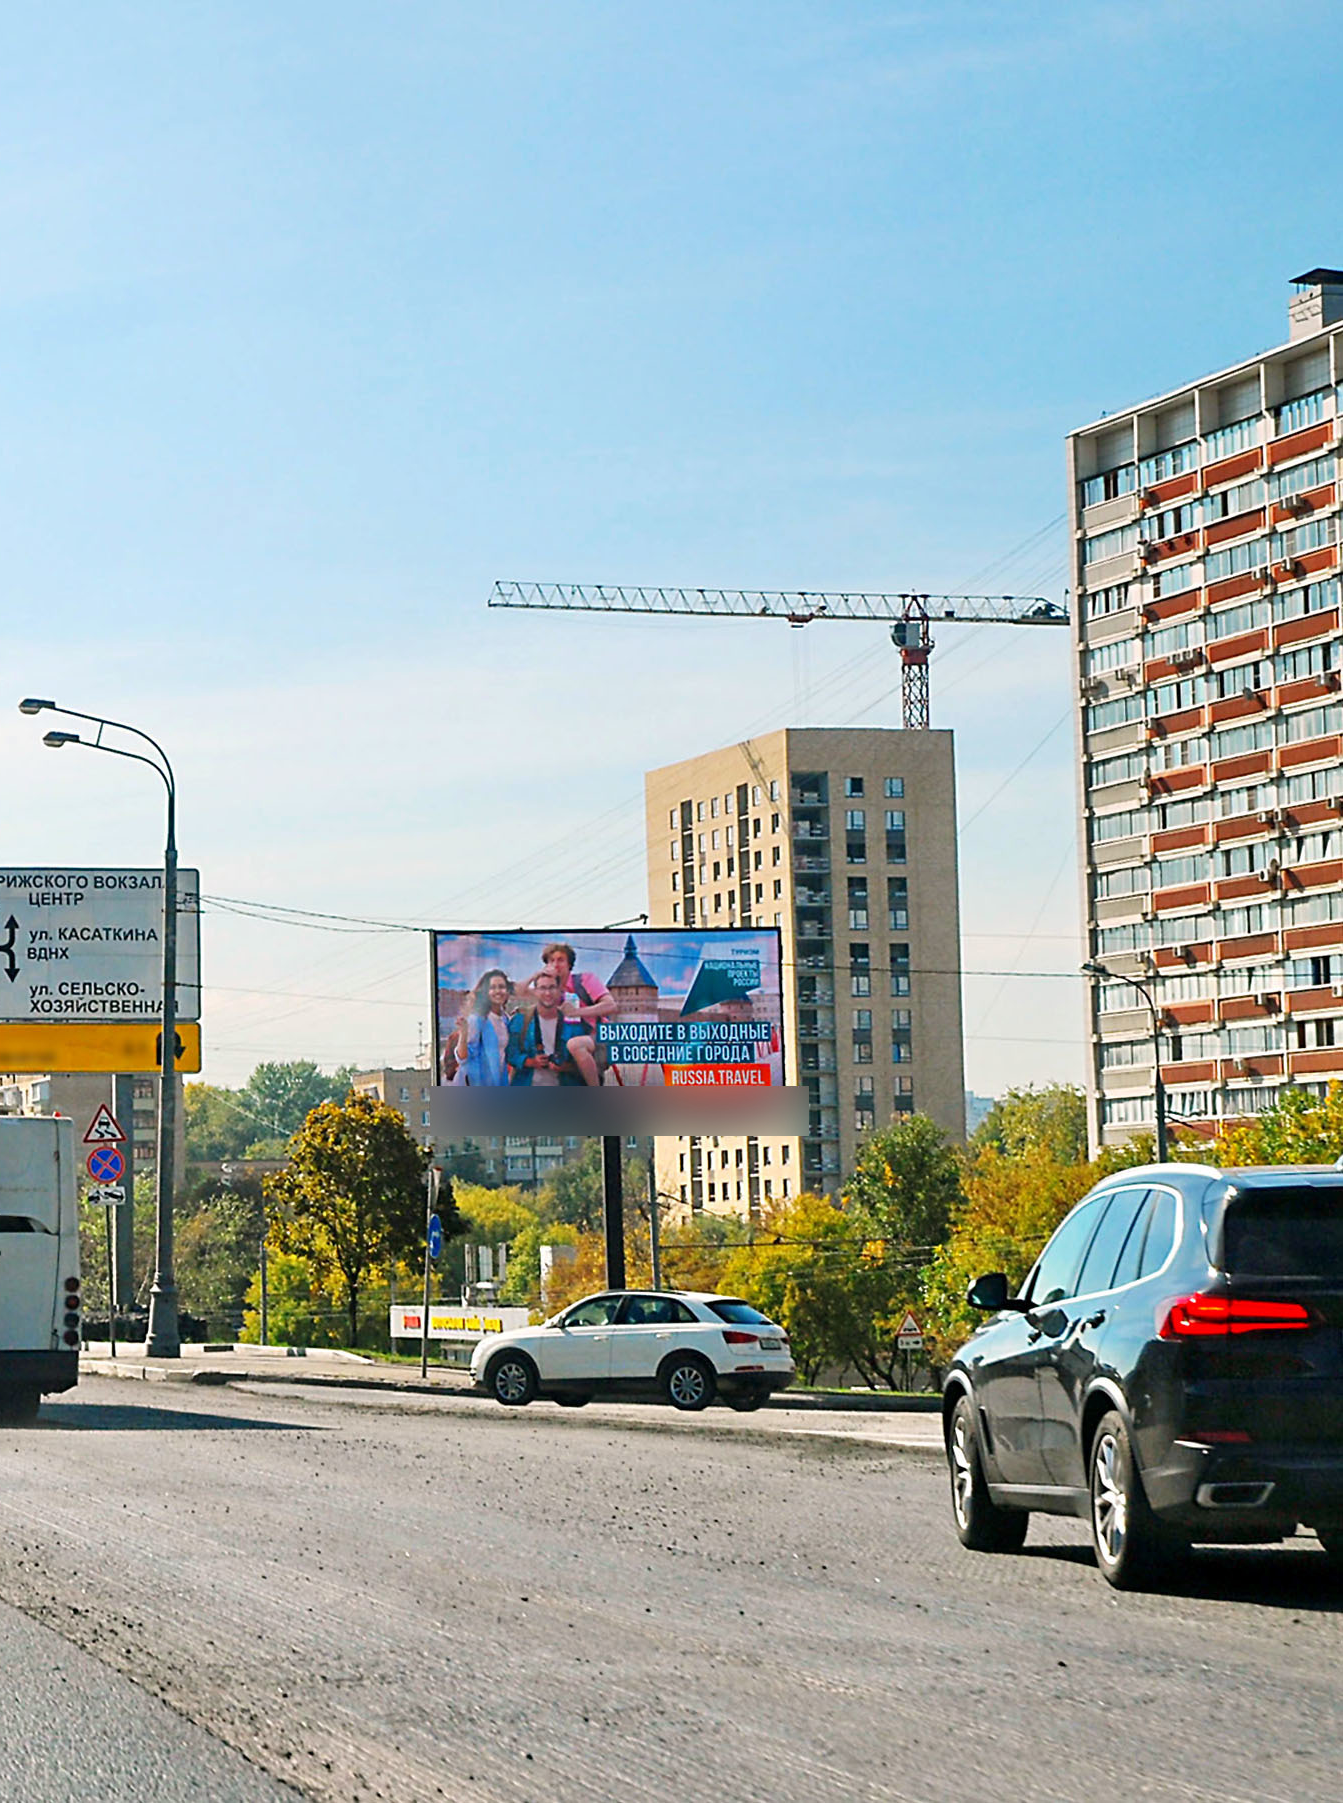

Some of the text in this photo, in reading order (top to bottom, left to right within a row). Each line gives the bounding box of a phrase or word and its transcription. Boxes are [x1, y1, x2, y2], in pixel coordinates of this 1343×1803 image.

[93, 876, 164, 889] ВОКЗАЛ
[29, 892, 84, 907] ЦЕНТР
[29, 927, 158, 943] ул. КАСАТКИНА
[27, 947, 69, 960] ВДНХ
[29, 982, 145, 998] ул. СЕЛЬСКО-
[599, 1024, 769, 1041] ВЫХОДИТЕ В ВЫХОДНЫЕ
[611, 1045, 750, 1062] В СОСЕДНИЕ ГОРОДА
[671, 1070, 766, 1085] RUSSIA.TRAVEL
